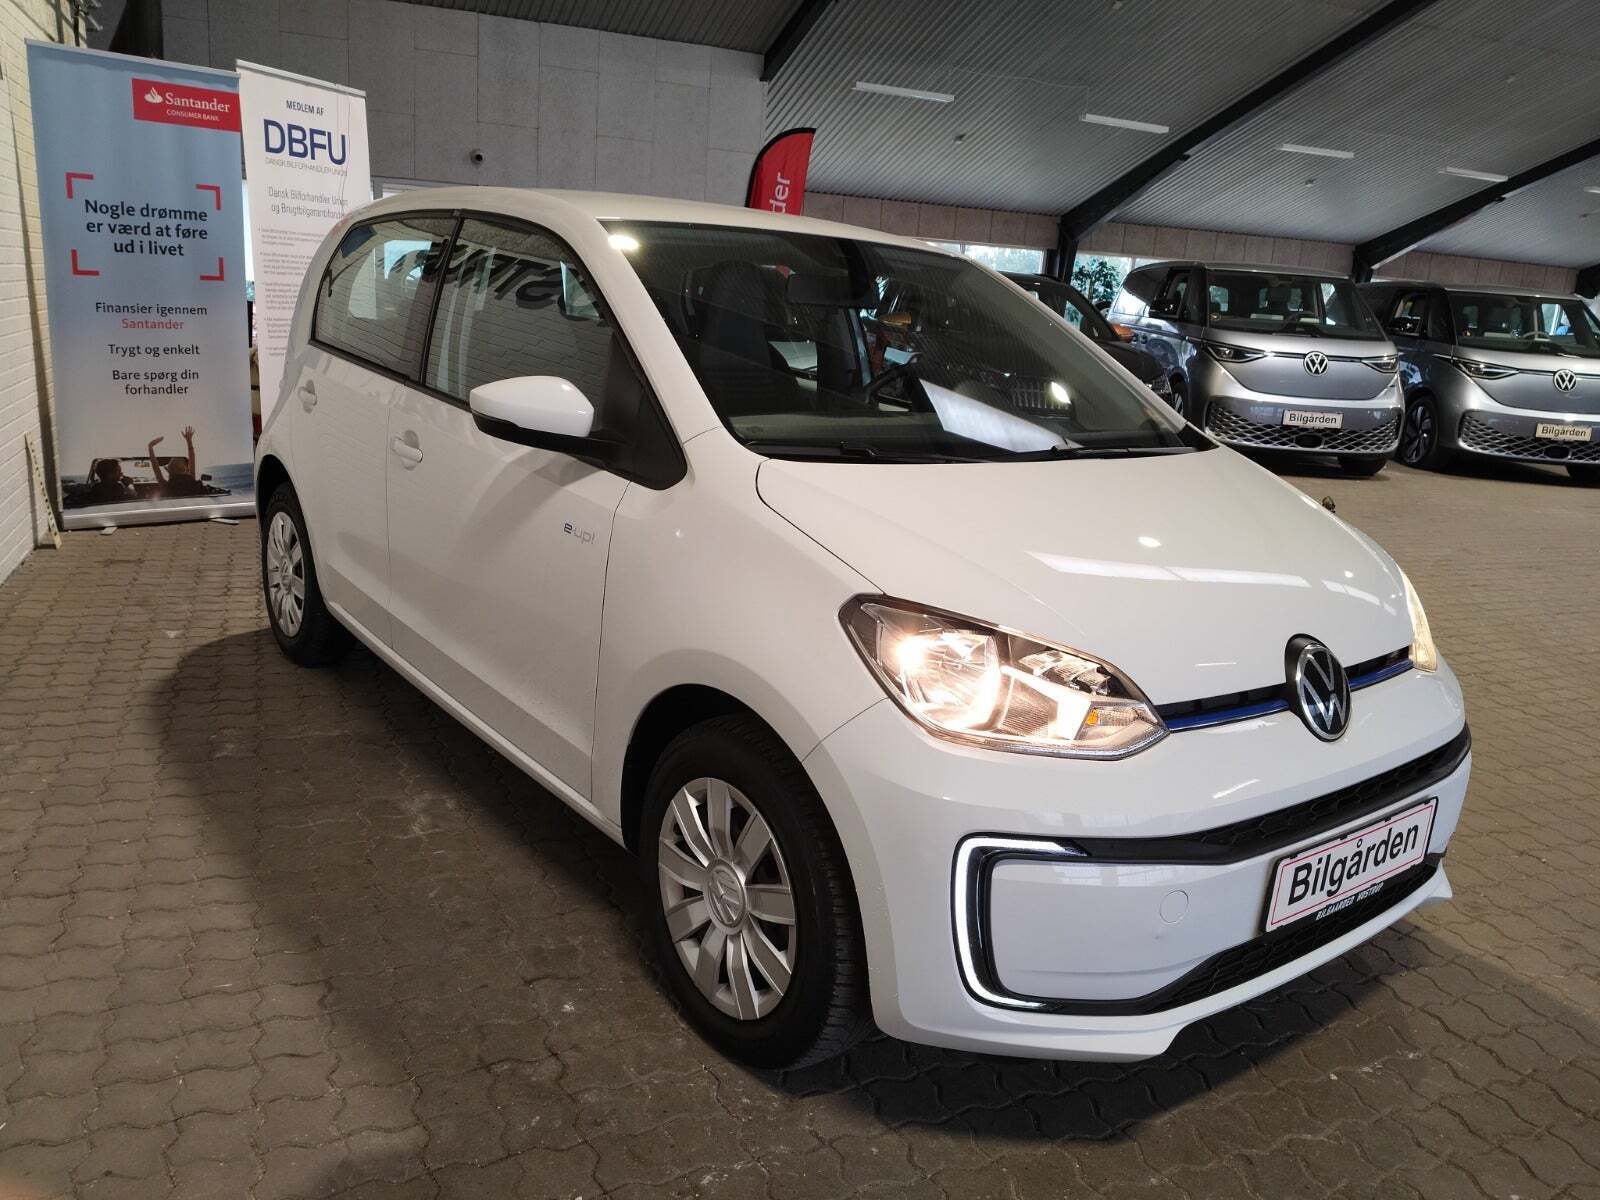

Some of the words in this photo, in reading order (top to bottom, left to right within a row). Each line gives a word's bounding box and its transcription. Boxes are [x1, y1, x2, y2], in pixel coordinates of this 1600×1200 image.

[165, 92, 231, 112] Santander
[286, 100, 315, 114] MEDLEM
[316, 107, 325, 116] AF
[166, 109, 201, 119] CONSUMER
[263, 119, 347, 165] DBFU
[268, 186, 289, 200] Dansk
[84, 199, 136, 219] Nogle
[140, 203, 208, 221] drømme
[86, 222, 103, 232] er
[107, 222, 151, 236] værd
[155, 225, 172, 238] at
[175, 224, 208, 239] føre
[113, 240, 135, 254] ud
[140, 240, 144, 254] i
[148, 241, 185, 256] livet
[95, 302, 152, 314] Finansier
[156, 304, 208, 317] igennem
[121, 318, 184, 329] Santander
[108, 344, 142, 358] Trygt
[144, 348, 160, 358] og
[163, 344, 200, 355] enkelt
[112, 370, 141, 380] Bare
[143, 371, 178, 382] spørg
[180, 368, 200, 380] din
[125, 384, 189, 395] forhandler
[1287, 824, 1419, 906] Bilgården
